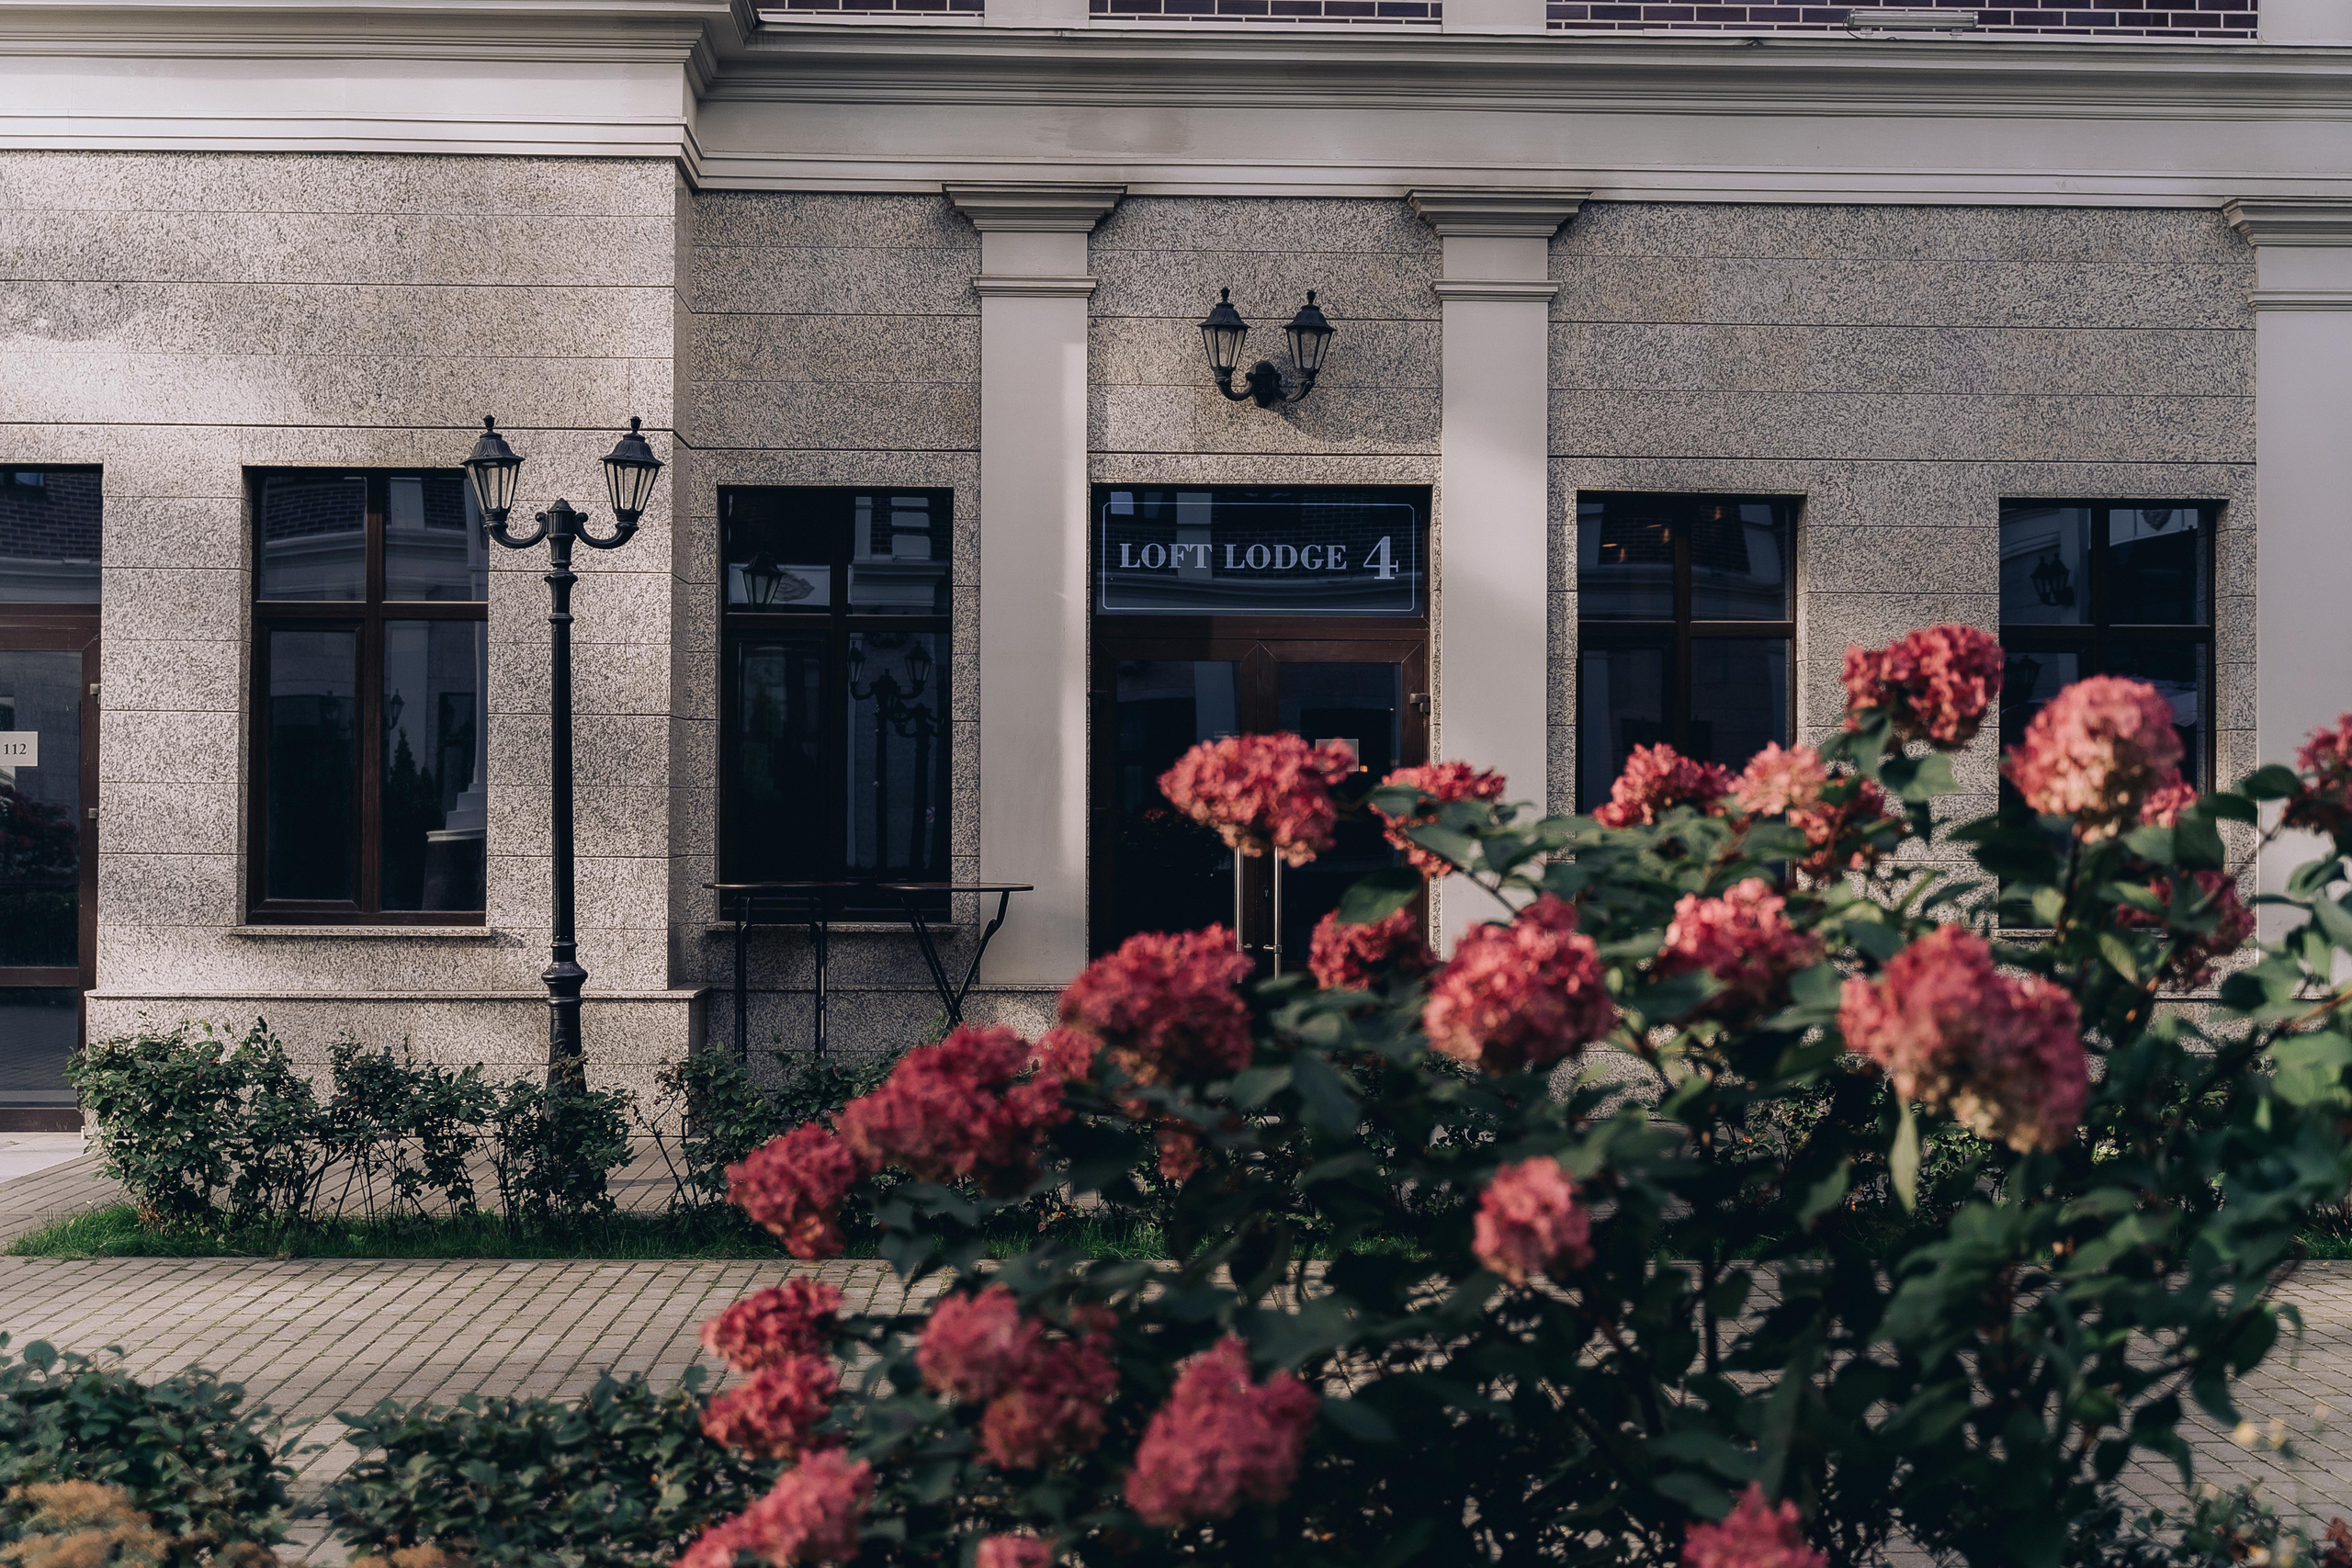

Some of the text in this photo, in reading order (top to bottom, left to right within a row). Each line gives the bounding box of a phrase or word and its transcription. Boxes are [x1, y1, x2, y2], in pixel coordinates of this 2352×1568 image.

[1119, 536, 1399, 580] LOFT LODGE 4
[4, 743, 28, 755] 112
